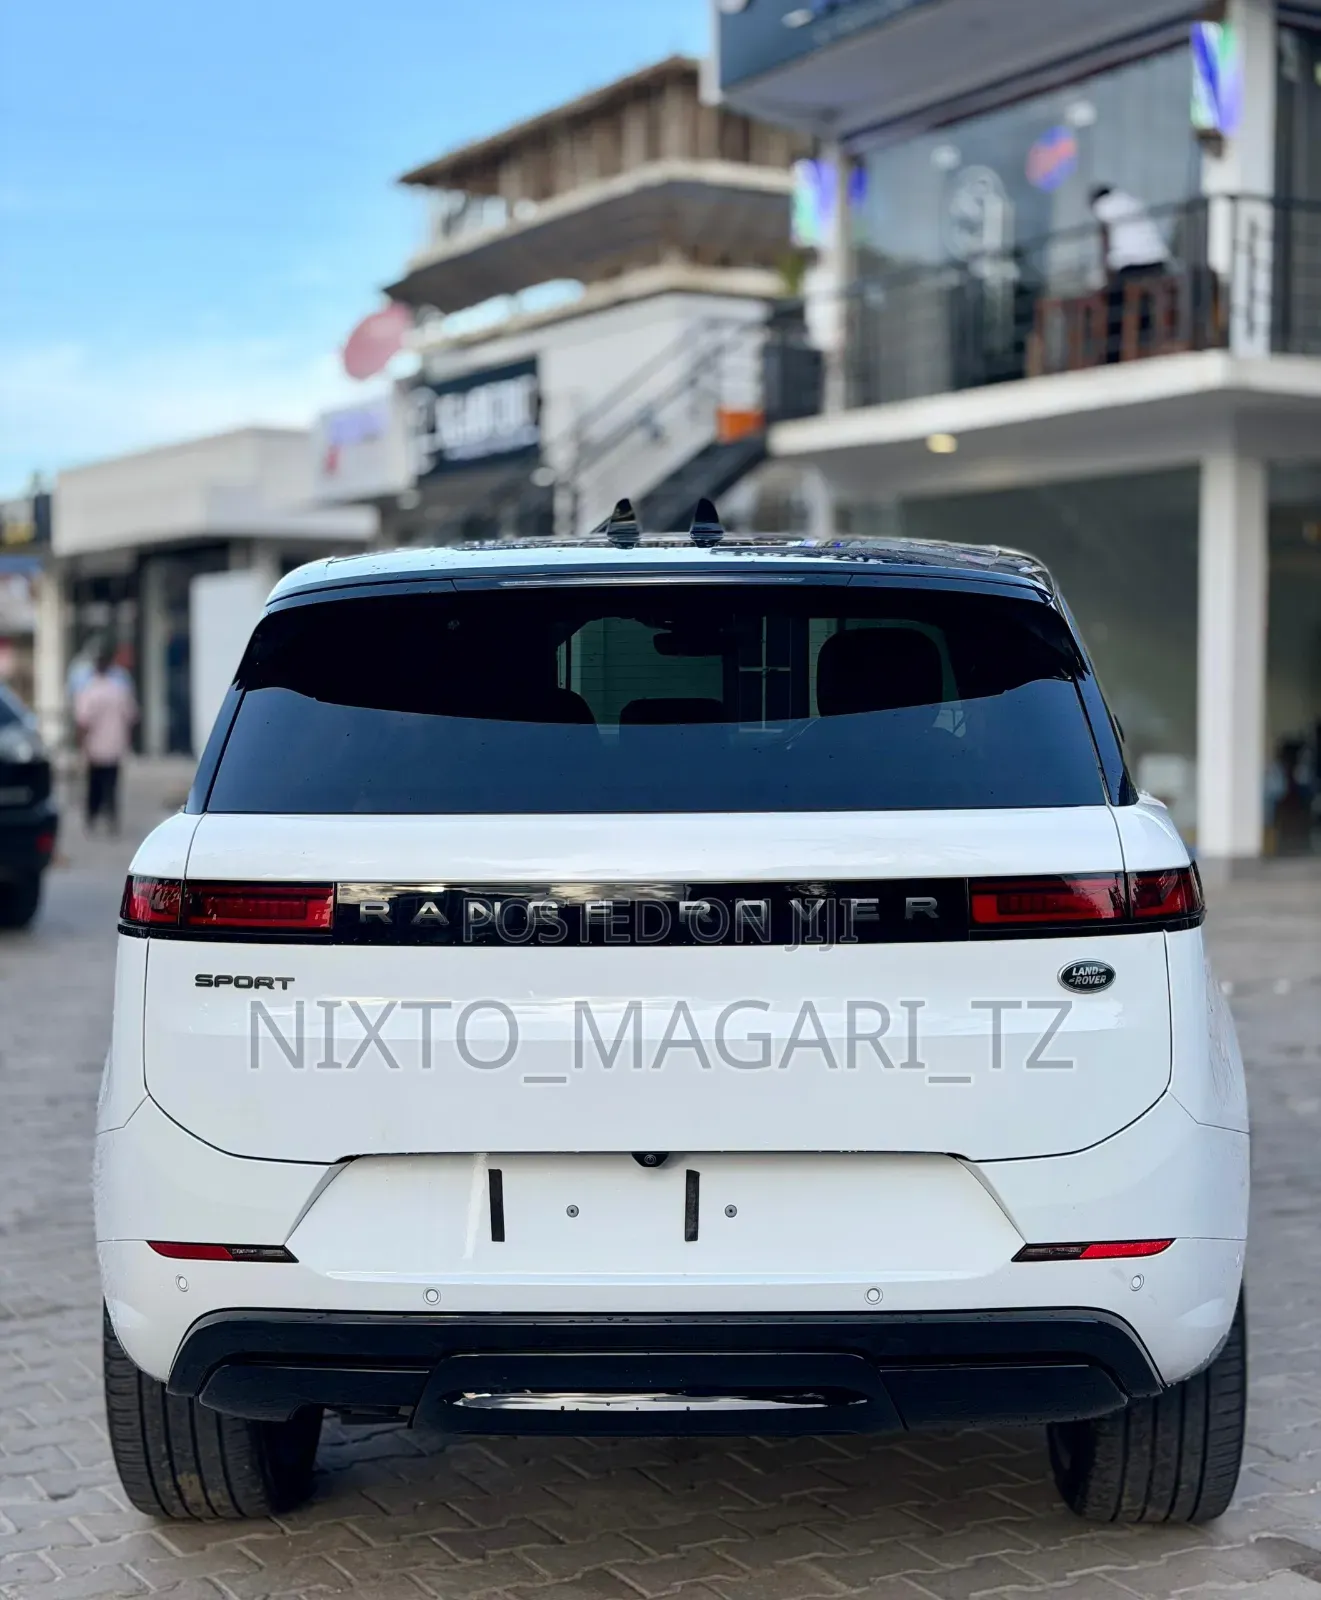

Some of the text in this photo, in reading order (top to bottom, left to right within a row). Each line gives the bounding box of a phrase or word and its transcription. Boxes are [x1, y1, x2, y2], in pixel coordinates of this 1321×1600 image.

[359, 896, 940, 925] RANGE ROVER
[1072, 966, 1098, 976] LAND
[195, 973, 295, 990] SPORT
[1074, 975, 1107, 985] ROVER
